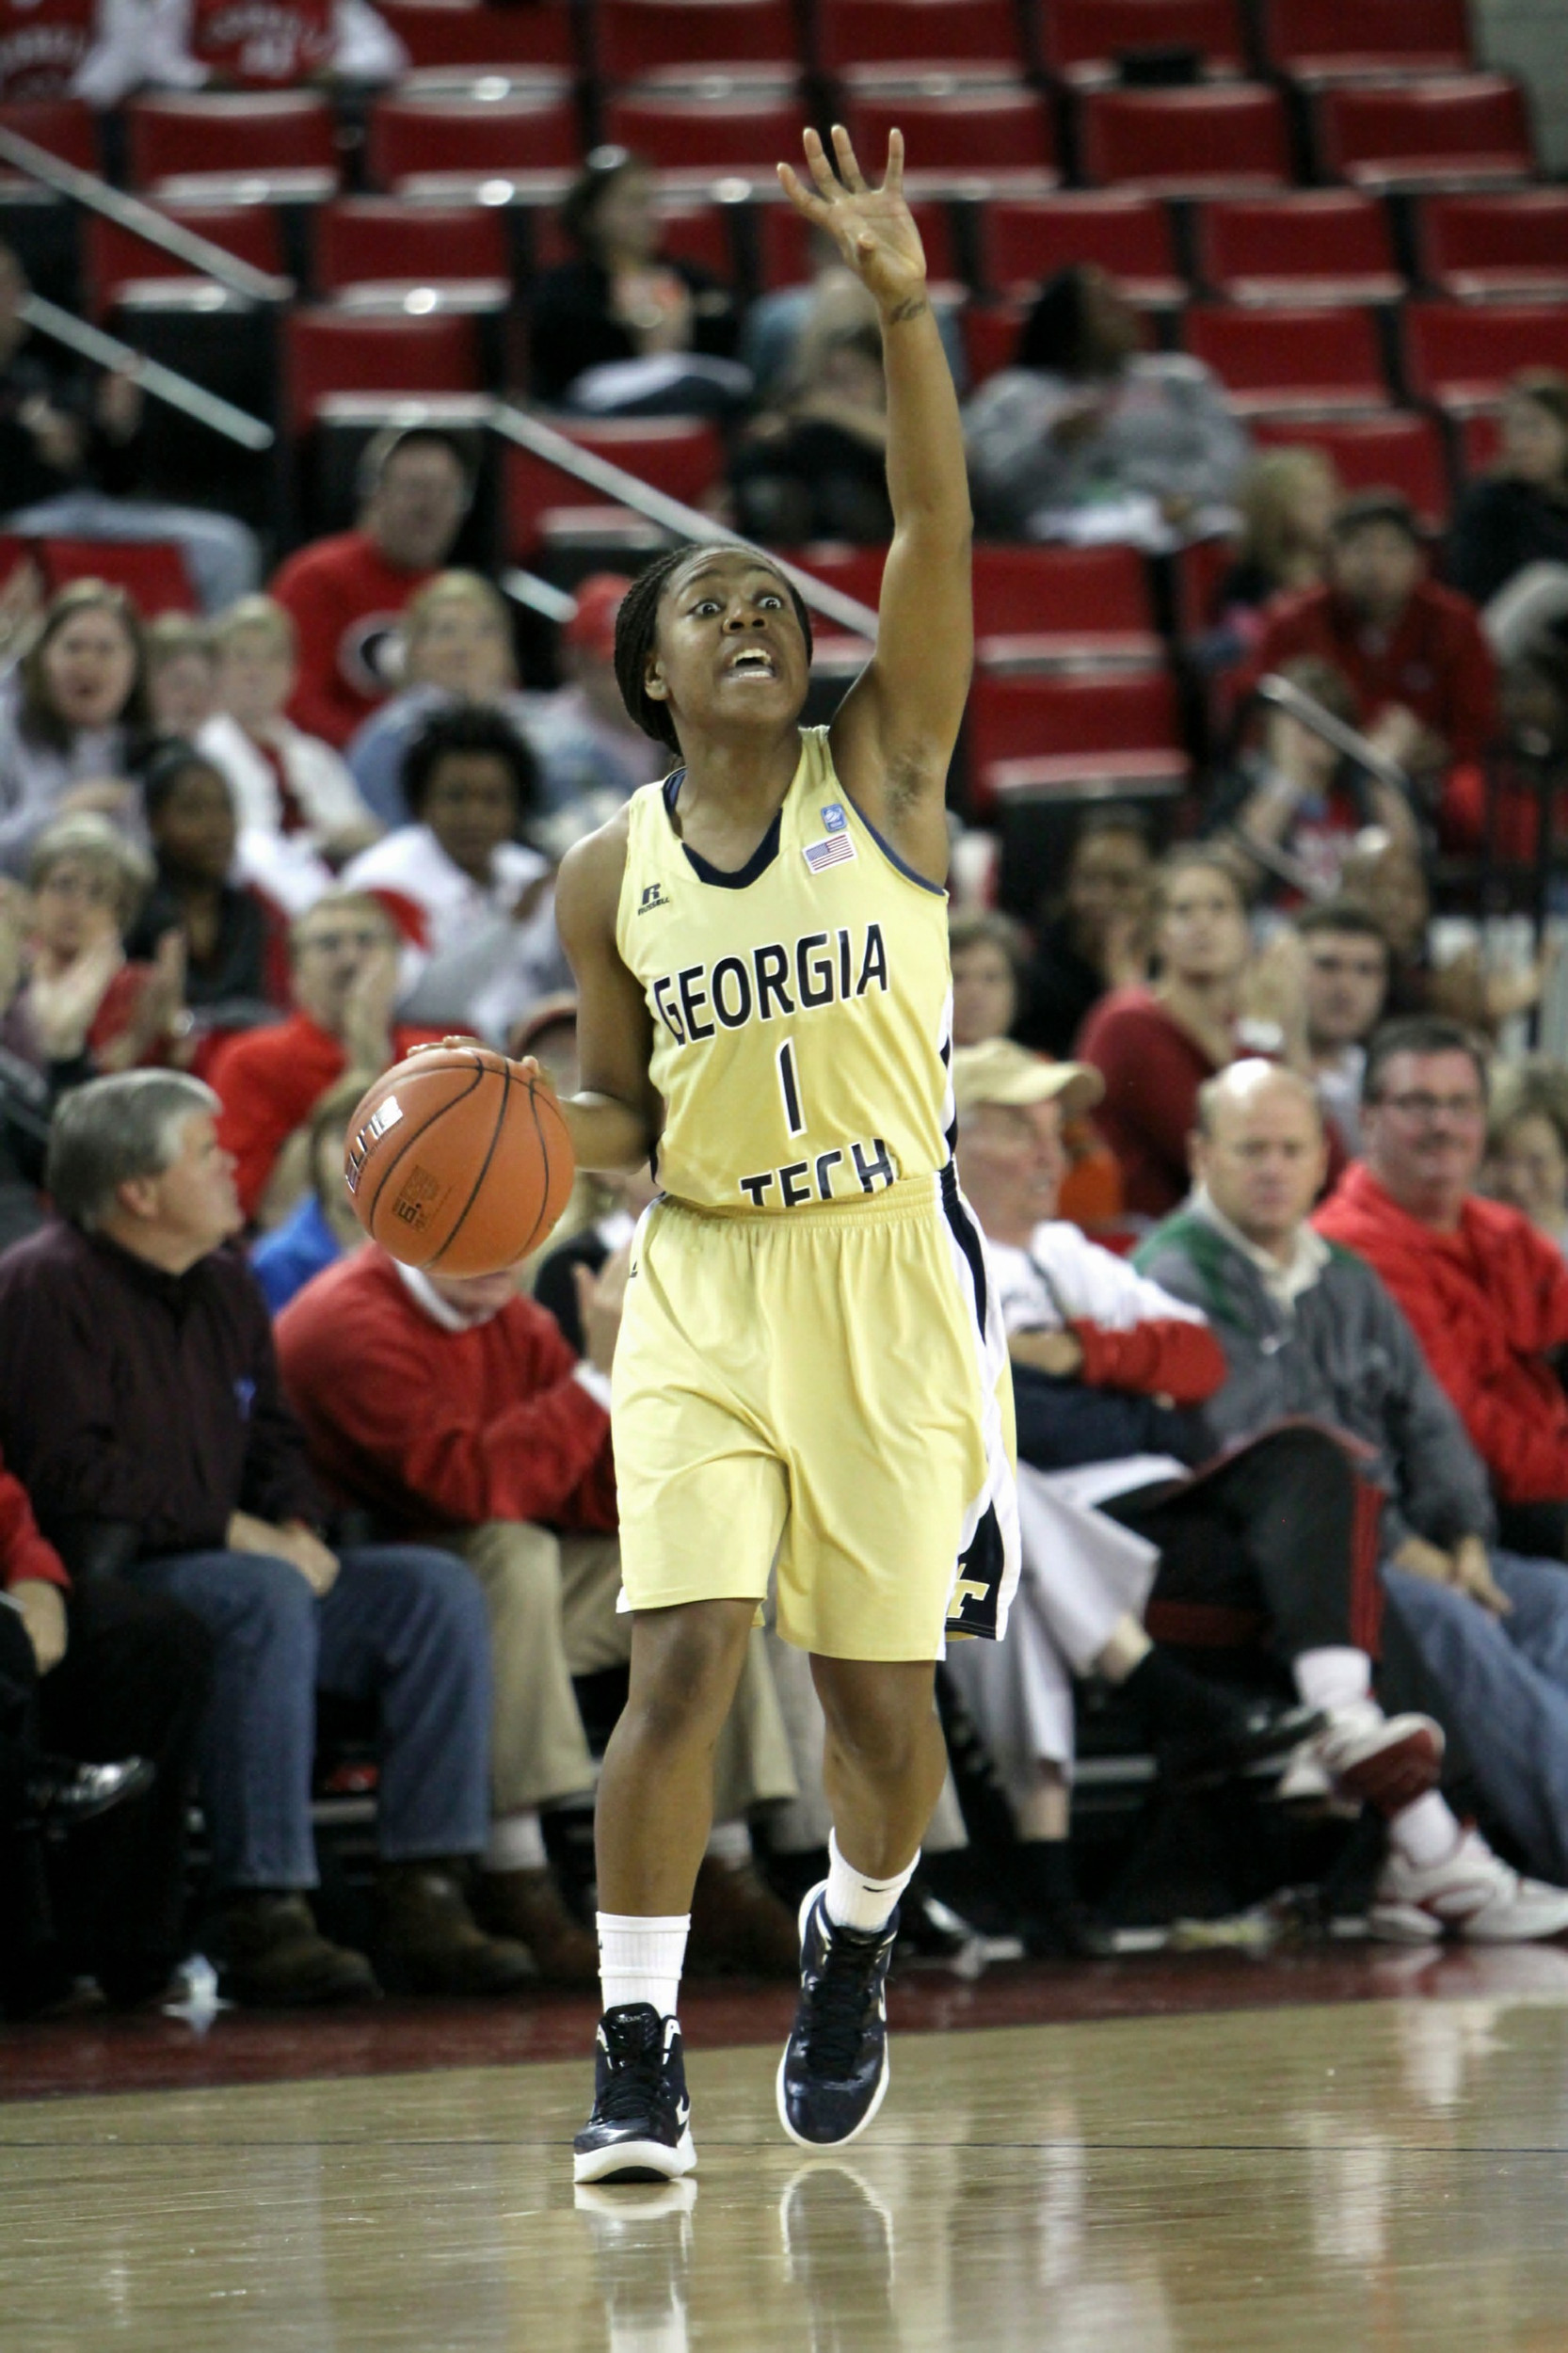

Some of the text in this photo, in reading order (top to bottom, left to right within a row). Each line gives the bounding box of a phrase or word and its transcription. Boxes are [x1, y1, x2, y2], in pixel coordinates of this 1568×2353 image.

[653, 923, 888, 1046] GEORGIA
[776, 1037, 807, 1139] 1
[740, 1138, 899, 1207] TECH
